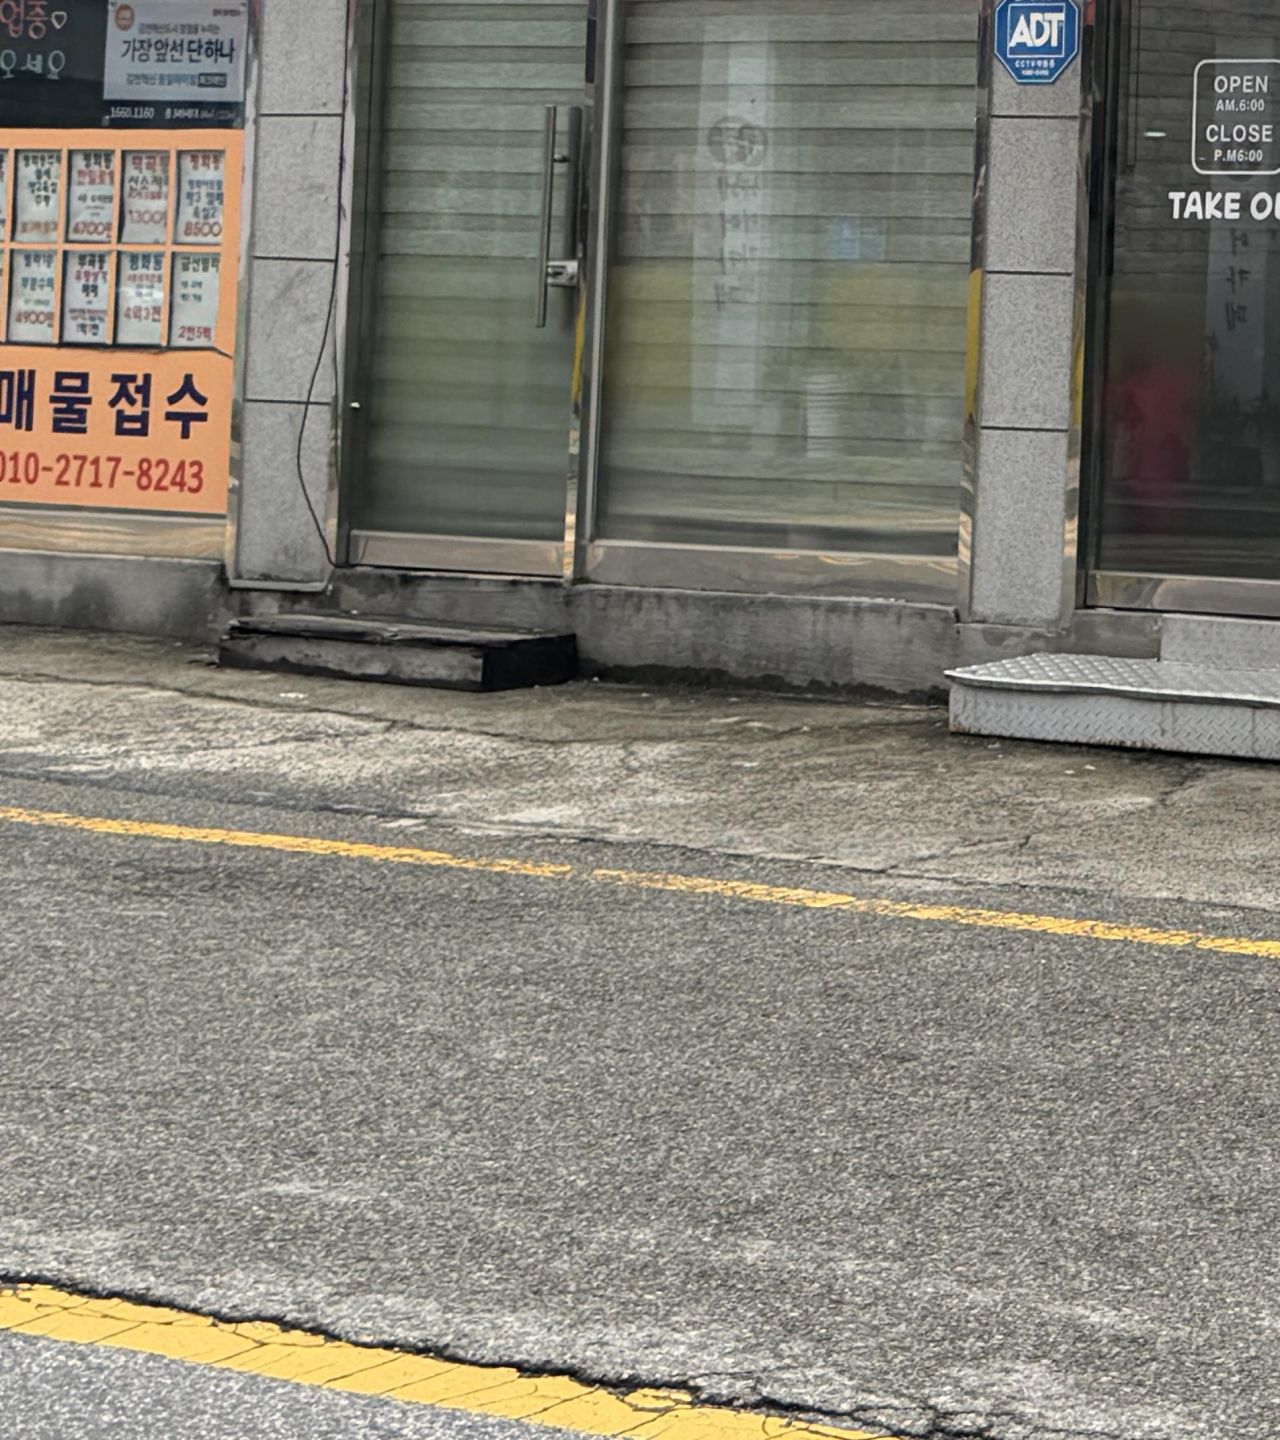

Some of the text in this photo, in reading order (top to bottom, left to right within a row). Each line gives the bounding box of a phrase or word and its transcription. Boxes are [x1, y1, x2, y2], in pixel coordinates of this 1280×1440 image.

[1008, 12, 1065, 48] ADT
[121, 38, 153, 64] 가장
[1214, 75, 1269, 93] OPEN
[1216, 99, 1265, 112] AM.6:00
[1206, 124, 1273, 143] CLOSE
[1168, 191, 1241, 220] TAKE
